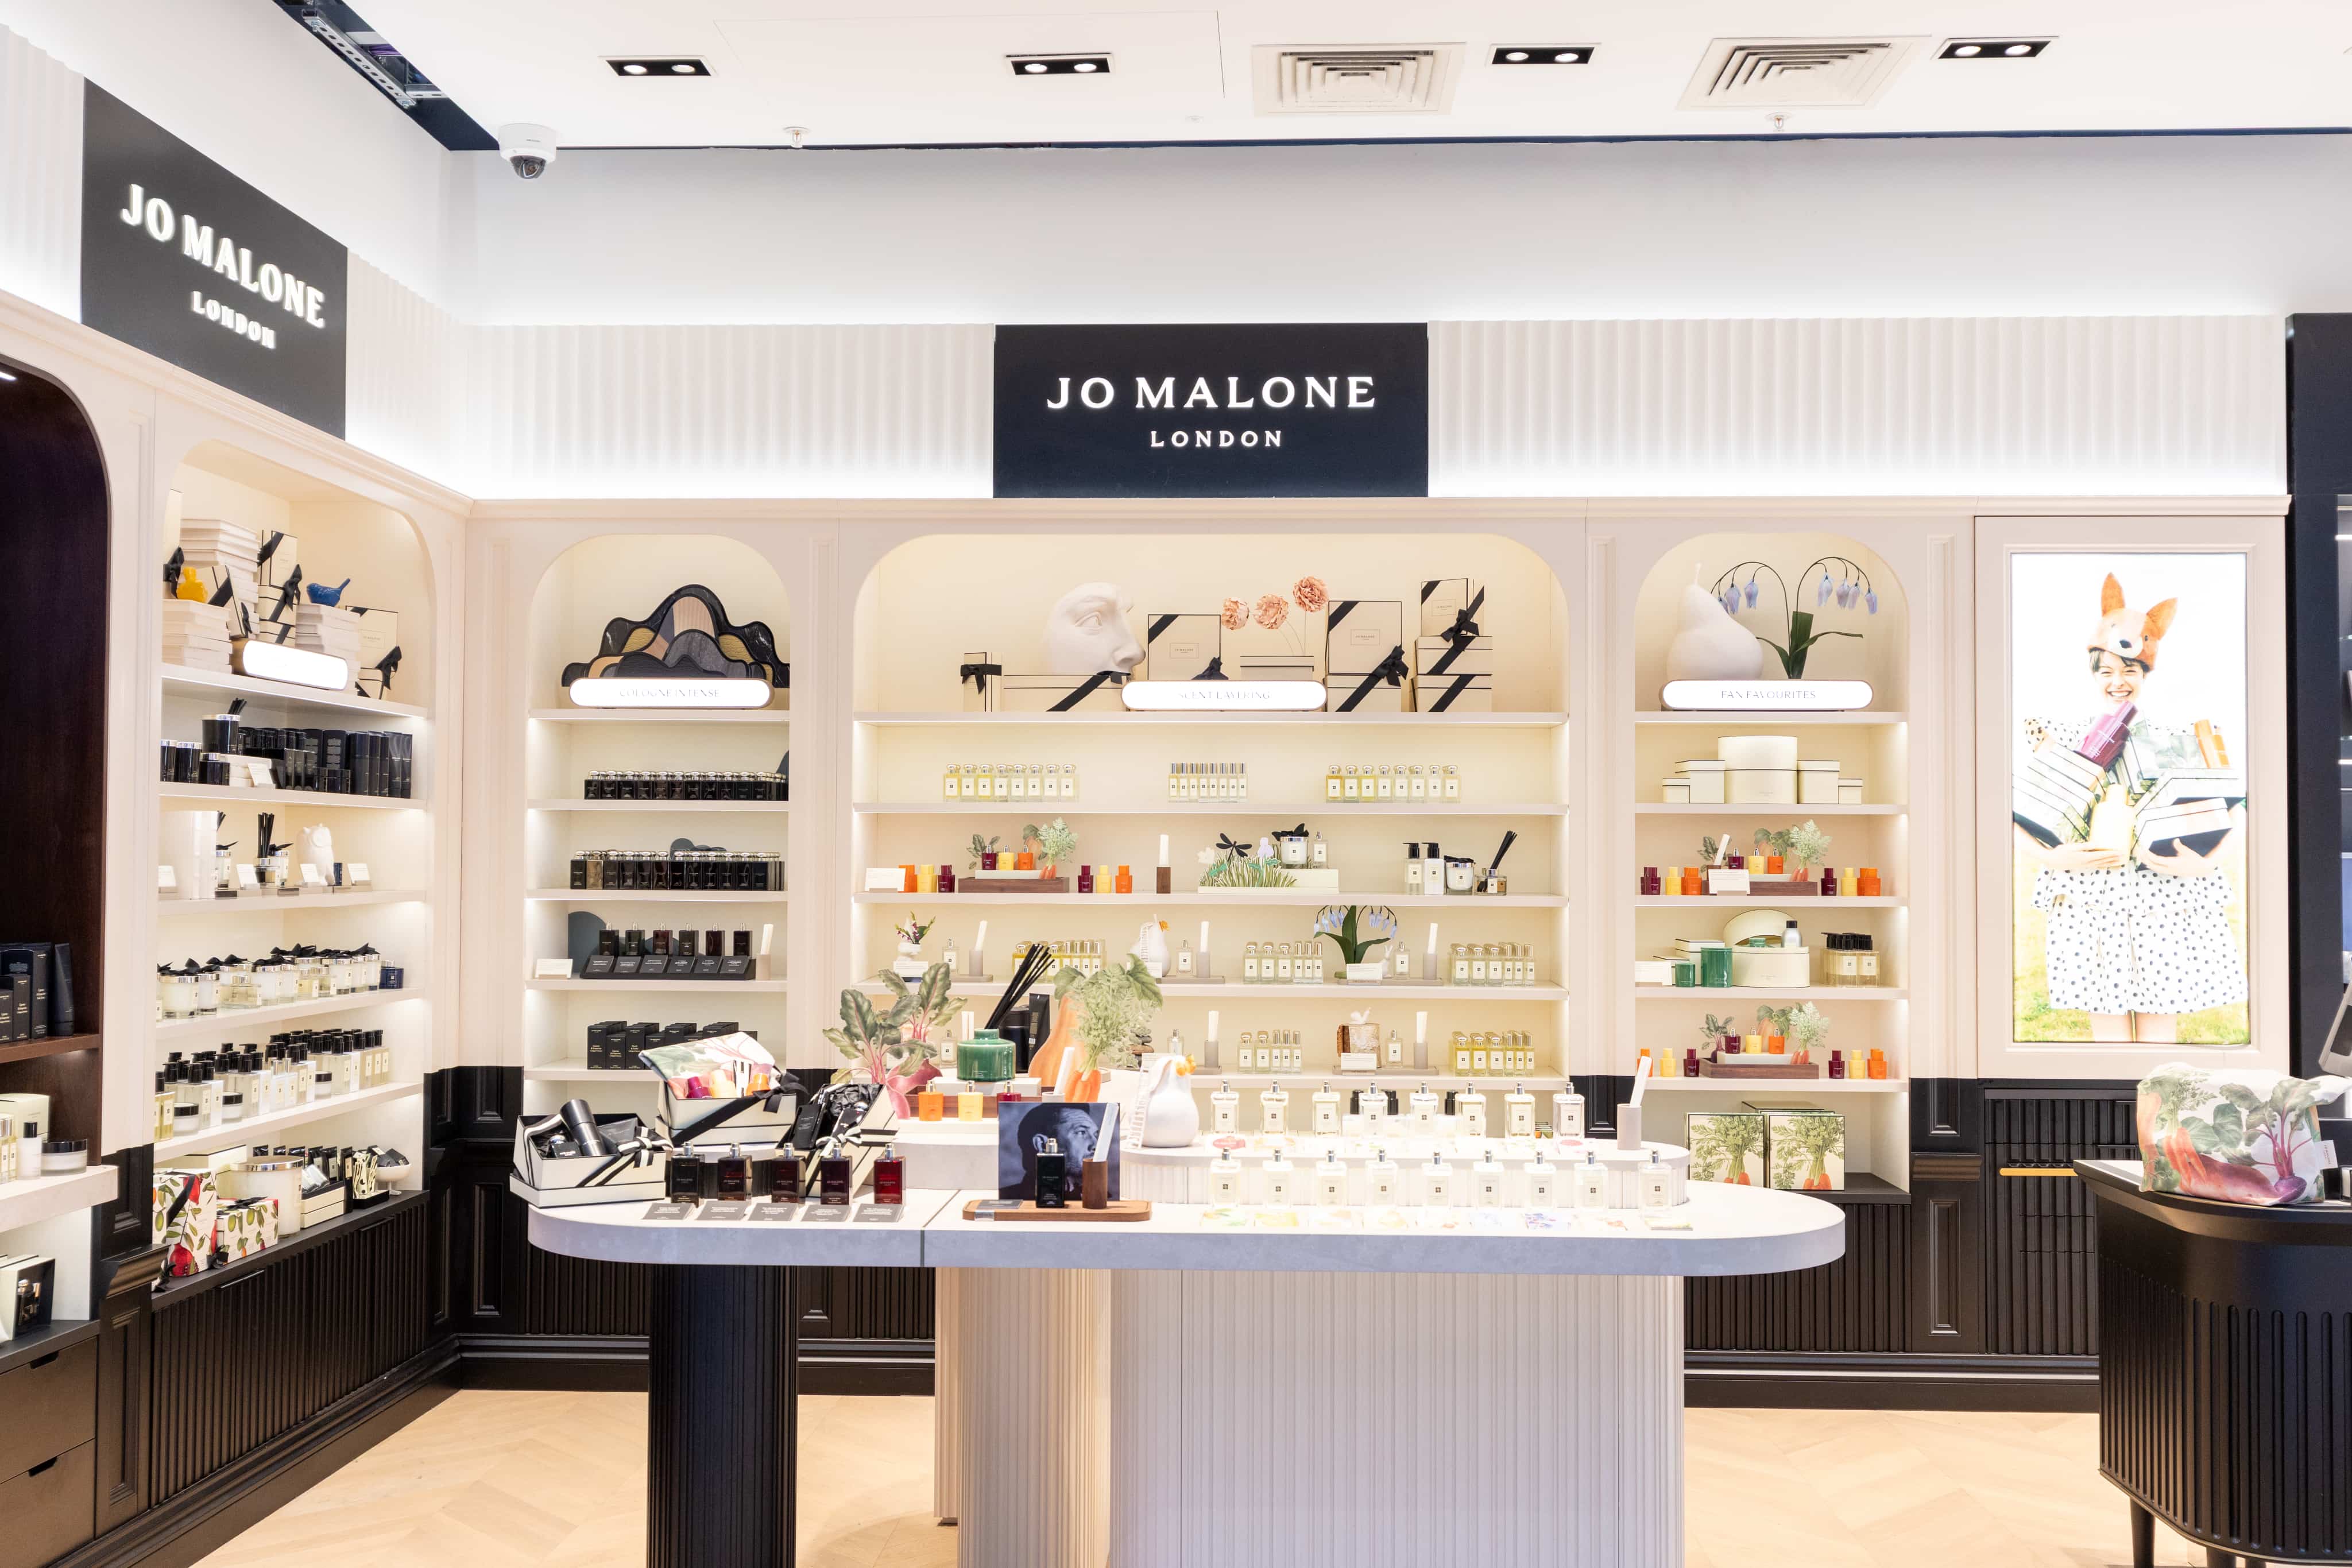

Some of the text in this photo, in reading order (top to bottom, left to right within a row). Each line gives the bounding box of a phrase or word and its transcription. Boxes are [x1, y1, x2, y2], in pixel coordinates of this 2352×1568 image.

[121, 184, 325, 328] JO MALONE
[191, 291, 276, 349] LONDON
[1047, 377, 1375, 409] JO MALONE
[1151, 431, 1281, 447] LONDON
[620, 688, 671, 698] COLOGNE
[1178, 691, 1270, 700] SCENT LAYERING
[1721, 690, 1816, 699] FAN FAVOURITES
